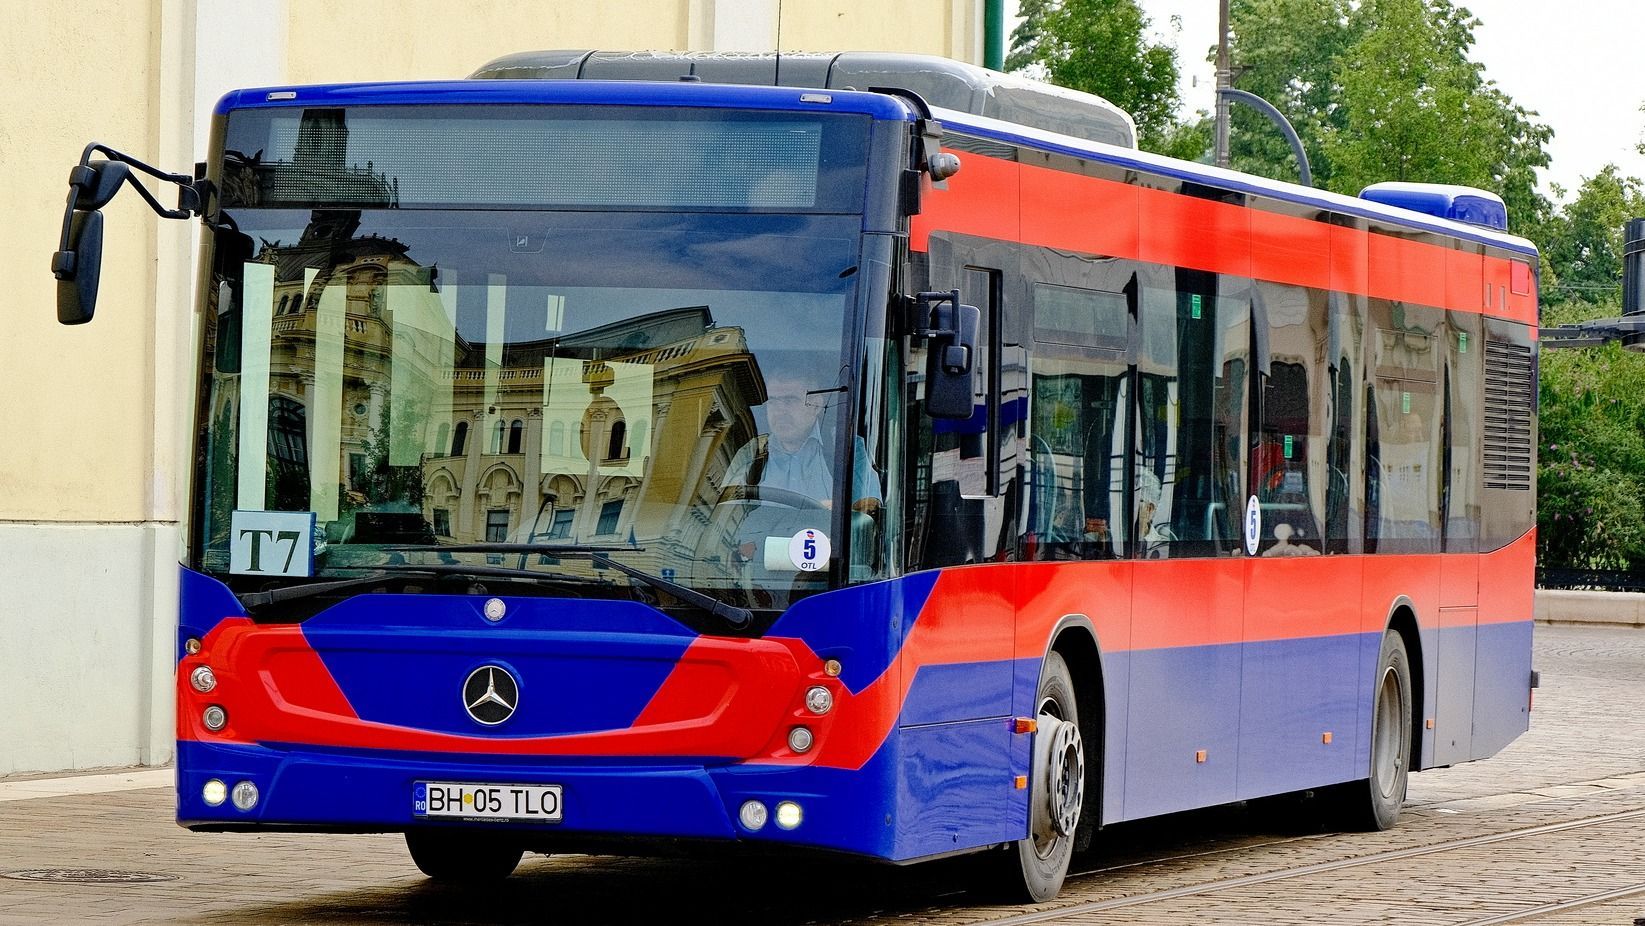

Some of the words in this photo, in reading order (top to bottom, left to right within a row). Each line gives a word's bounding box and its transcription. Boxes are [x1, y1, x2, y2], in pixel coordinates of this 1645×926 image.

[1250, 510, 1256, 540] 5
[239, 529, 301, 574] T7
[803, 539, 816, 560] 5
[801, 562, 817, 570] OTL
[415, 800, 426, 811] RO
[429, 787, 463, 812] BH
[473, 788, 502, 813] 05
[510, 789, 558, 815] TLO
